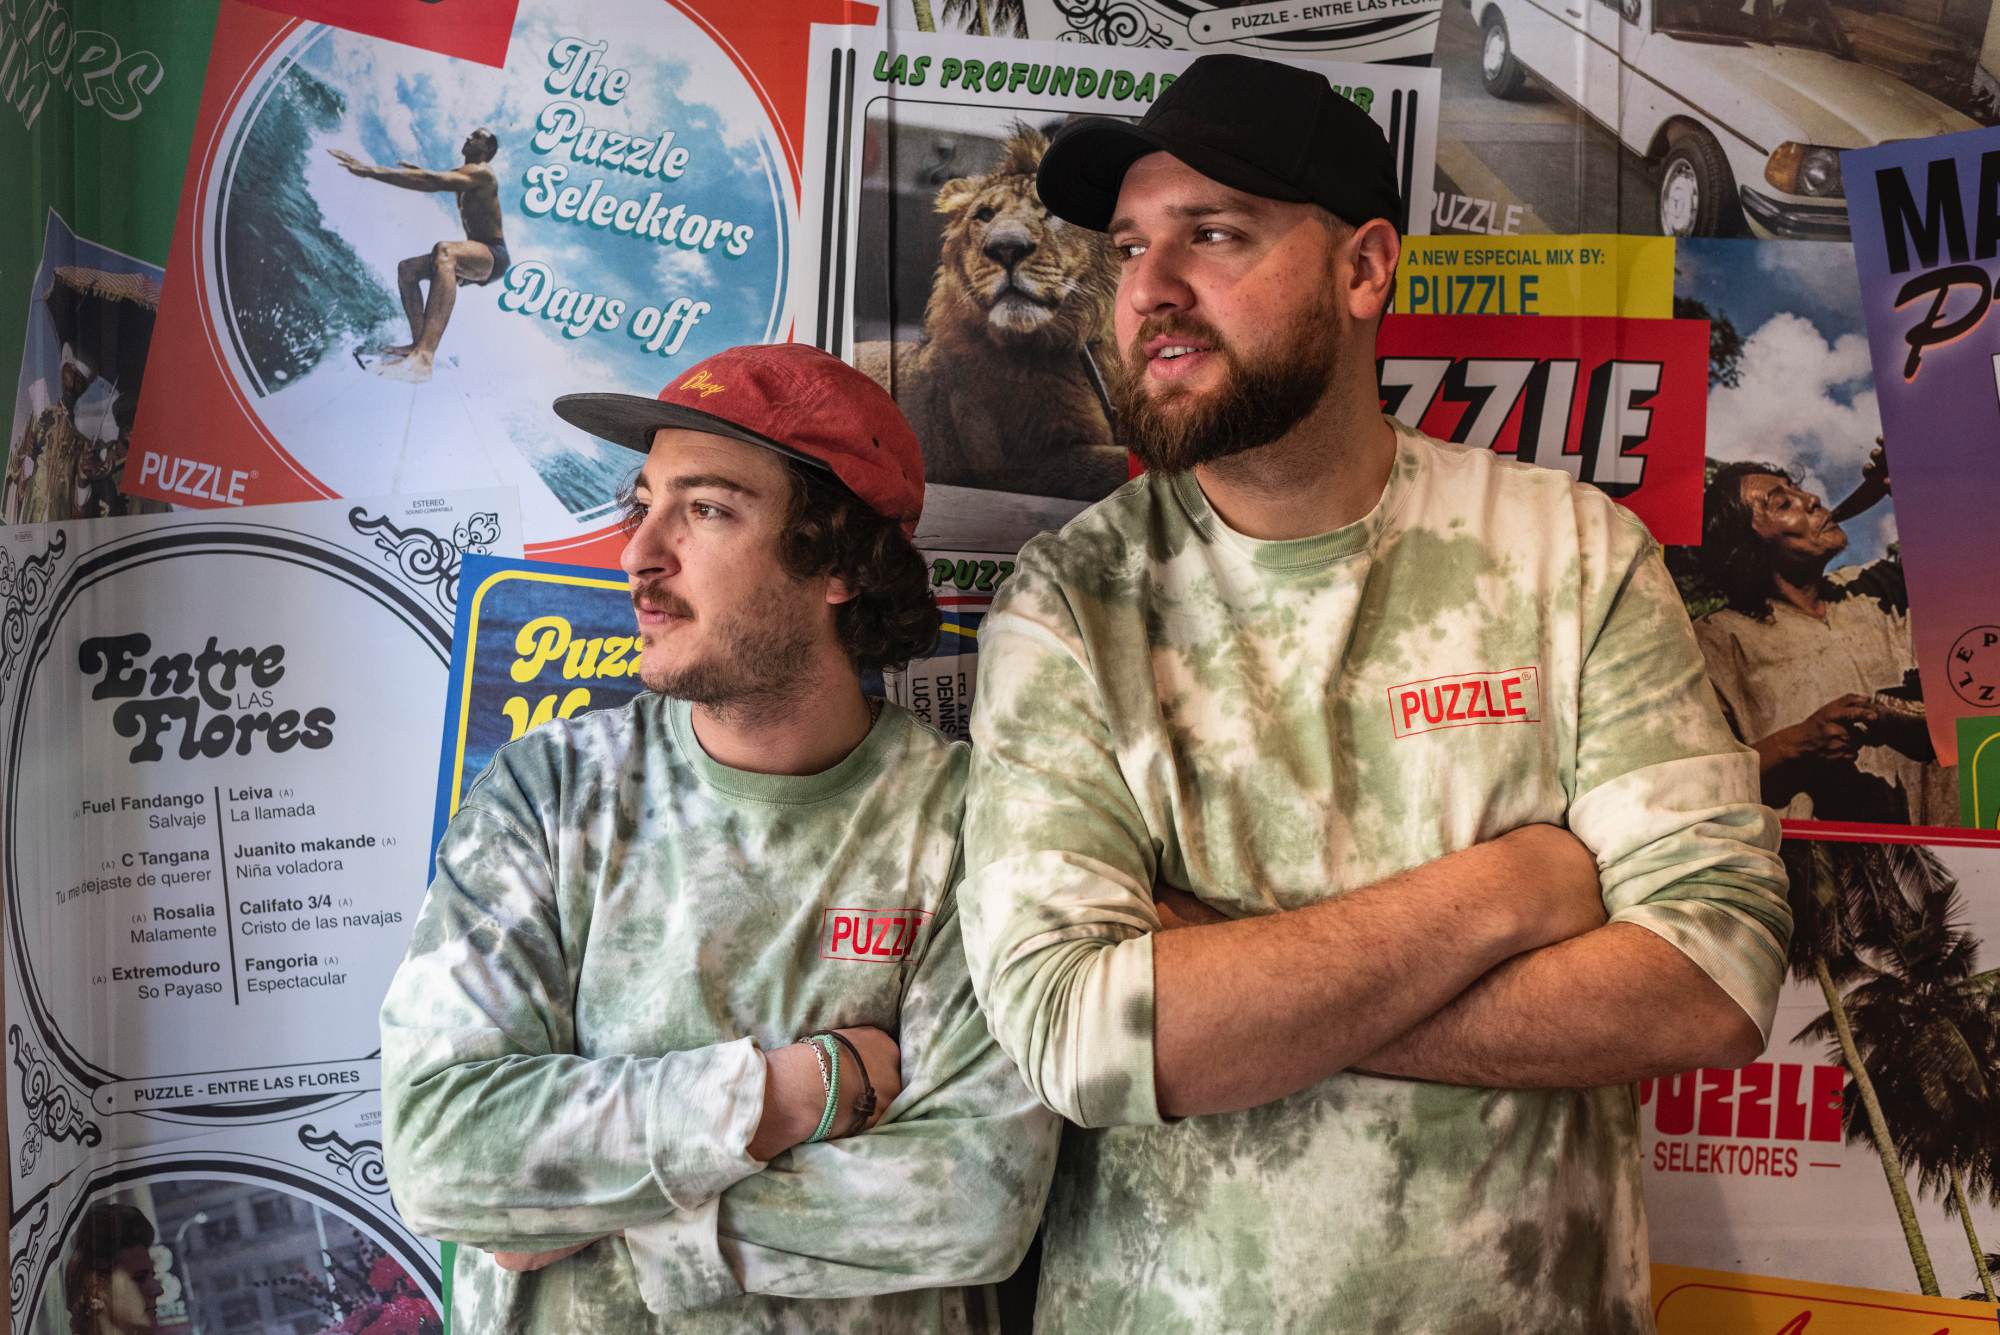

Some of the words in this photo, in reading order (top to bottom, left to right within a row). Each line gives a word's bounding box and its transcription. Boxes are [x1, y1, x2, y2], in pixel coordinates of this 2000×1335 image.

[1232, 11, 1289, 30] PUZZLE
[1303, 1, 1353, 20] ENTRE
[544, 37, 631, 105] The
[873, 51, 932, 86] LAS
[531, 101, 690, 182] Puzzle
[520, 163, 754, 260] Selecktors
[1407, 250, 1418, 266] A
[1423, 250, 1459, 265] NEW
[1464, 249, 1541, 266] ESPECIAL
[1546, 249, 1574, 265] MIX
[1579, 249, 1605, 265] BY:
[498, 260, 626, 340] Days
[627, 297, 711, 355] off
[1410, 275, 1539, 316] PUZZLE
[1377, 357, 1664, 497] ZZLE
[139, 451, 248, 506] PUZZLE
[412, 498, 445, 509] ESTEREO
[78, 633, 285, 711] Entre
[237, 690, 274, 710] LAS
[912, 677, 932, 723] LUCK
[936, 675, 957, 734] DENNIS
[1400, 677, 1526, 729] PUZZLE
[113, 696, 336, 764] Flores
[82, 798, 115, 815] Fuel
[121, 792, 205, 810] Fandango
[228, 786, 273, 801] Leiva
[279, 788, 294, 799] (A)
[149, 812, 206, 829] Salvaje
[231, 808, 250, 822] La
[255, 803, 316, 820] llamada
[122, 853, 134, 867] C
[138, 850, 210, 867] Tangana
[234, 841, 296, 858] Juanito
[301, 834, 376, 853] makande
[236, 864, 272, 879] Niña
[276, 858, 344, 875] voladora
[56, 890, 66, 905] Tu
[68, 885, 80, 900] me
[81, 875, 132, 895] dejaste
[136, 872, 156, 887] de
[161, 870, 212, 887] querer
[153, 903, 215, 921] Rosalia
[239, 898, 303, 915] Califato
[308, 894, 332, 909] 3/4
[130, 924, 217, 943] Malamente
[241, 918, 287, 936] Cristo
[291, 917, 311, 931] de
[315, 915, 338, 929] las
[343, 910, 403, 927] navajas
[112, 961, 220, 981] Extremoduro
[245, 953, 318, 972] Fangoria
[138, 985, 159, 999] So
[165, 981, 222, 999] Payaso
[247, 971, 347, 993] Espectacular
[134, 1085, 194, 1102] PUZZLE
[207, 1079, 260, 1096] ENTRE
[263, 1075, 294, 1091] LAS
[298, 1070, 361, 1087] FLORES
[1653, 1141, 1798, 1178] SELEKTORES
